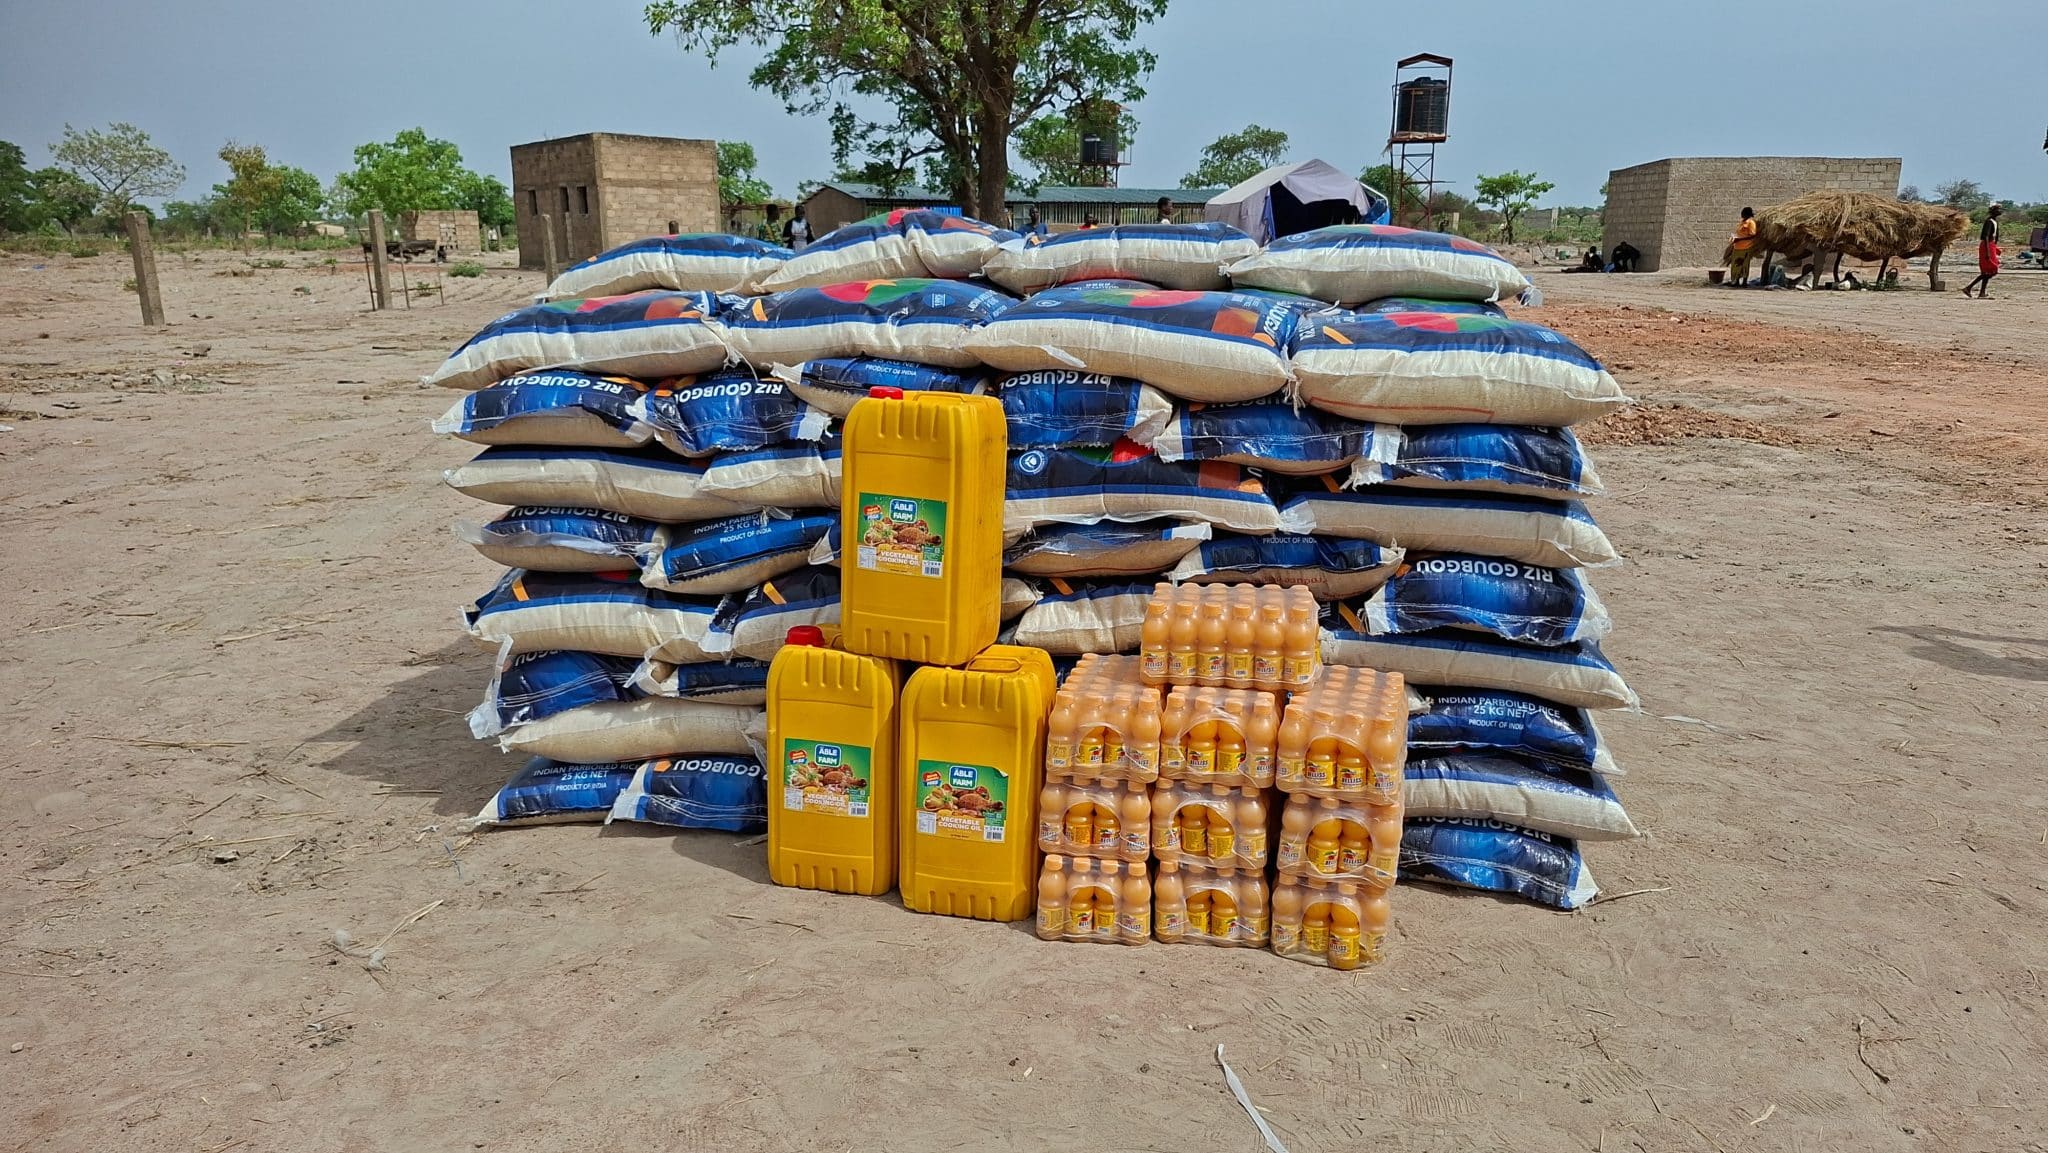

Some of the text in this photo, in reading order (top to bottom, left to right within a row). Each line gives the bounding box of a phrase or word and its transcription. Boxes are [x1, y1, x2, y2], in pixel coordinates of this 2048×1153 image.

[500, 375, 624, 396] RIZ GOUBGOU
[755, 382, 783, 396] RIZ
[893, 512, 913, 521] FARM
[694, 521, 727, 535] INDIAN
[729, 513, 759, 525] PARBO
[723, 524, 735, 533] 25
[737, 522, 750, 530] KG
[720, 533, 746, 544] PRODUCT
[746, 530, 755, 538] OF
[879, 557, 908, 565] COOKING
[880, 551, 920, 561] VEGETABLE
[1416, 559, 1554, 584] RIZ GOUBGOU
[1438, 697, 1561, 718] INDIAN PARBOILED RICE
[1473, 705, 1527, 719] 25 KG NET
[1468, 719, 1497, 728] PRODUCT
[1498, 721, 1507, 729] OF
[818, 757, 838, 765] FARM
[534, 766, 566, 777] INDIAN
[673, 760, 760, 777] GOUBGOU
[560, 770, 609, 781] 25 KG NET
[952, 778, 973, 787] FARM
[938, 821, 982, 832] COOKING OIL
[941, 816, 980, 826] VEGETABLE
